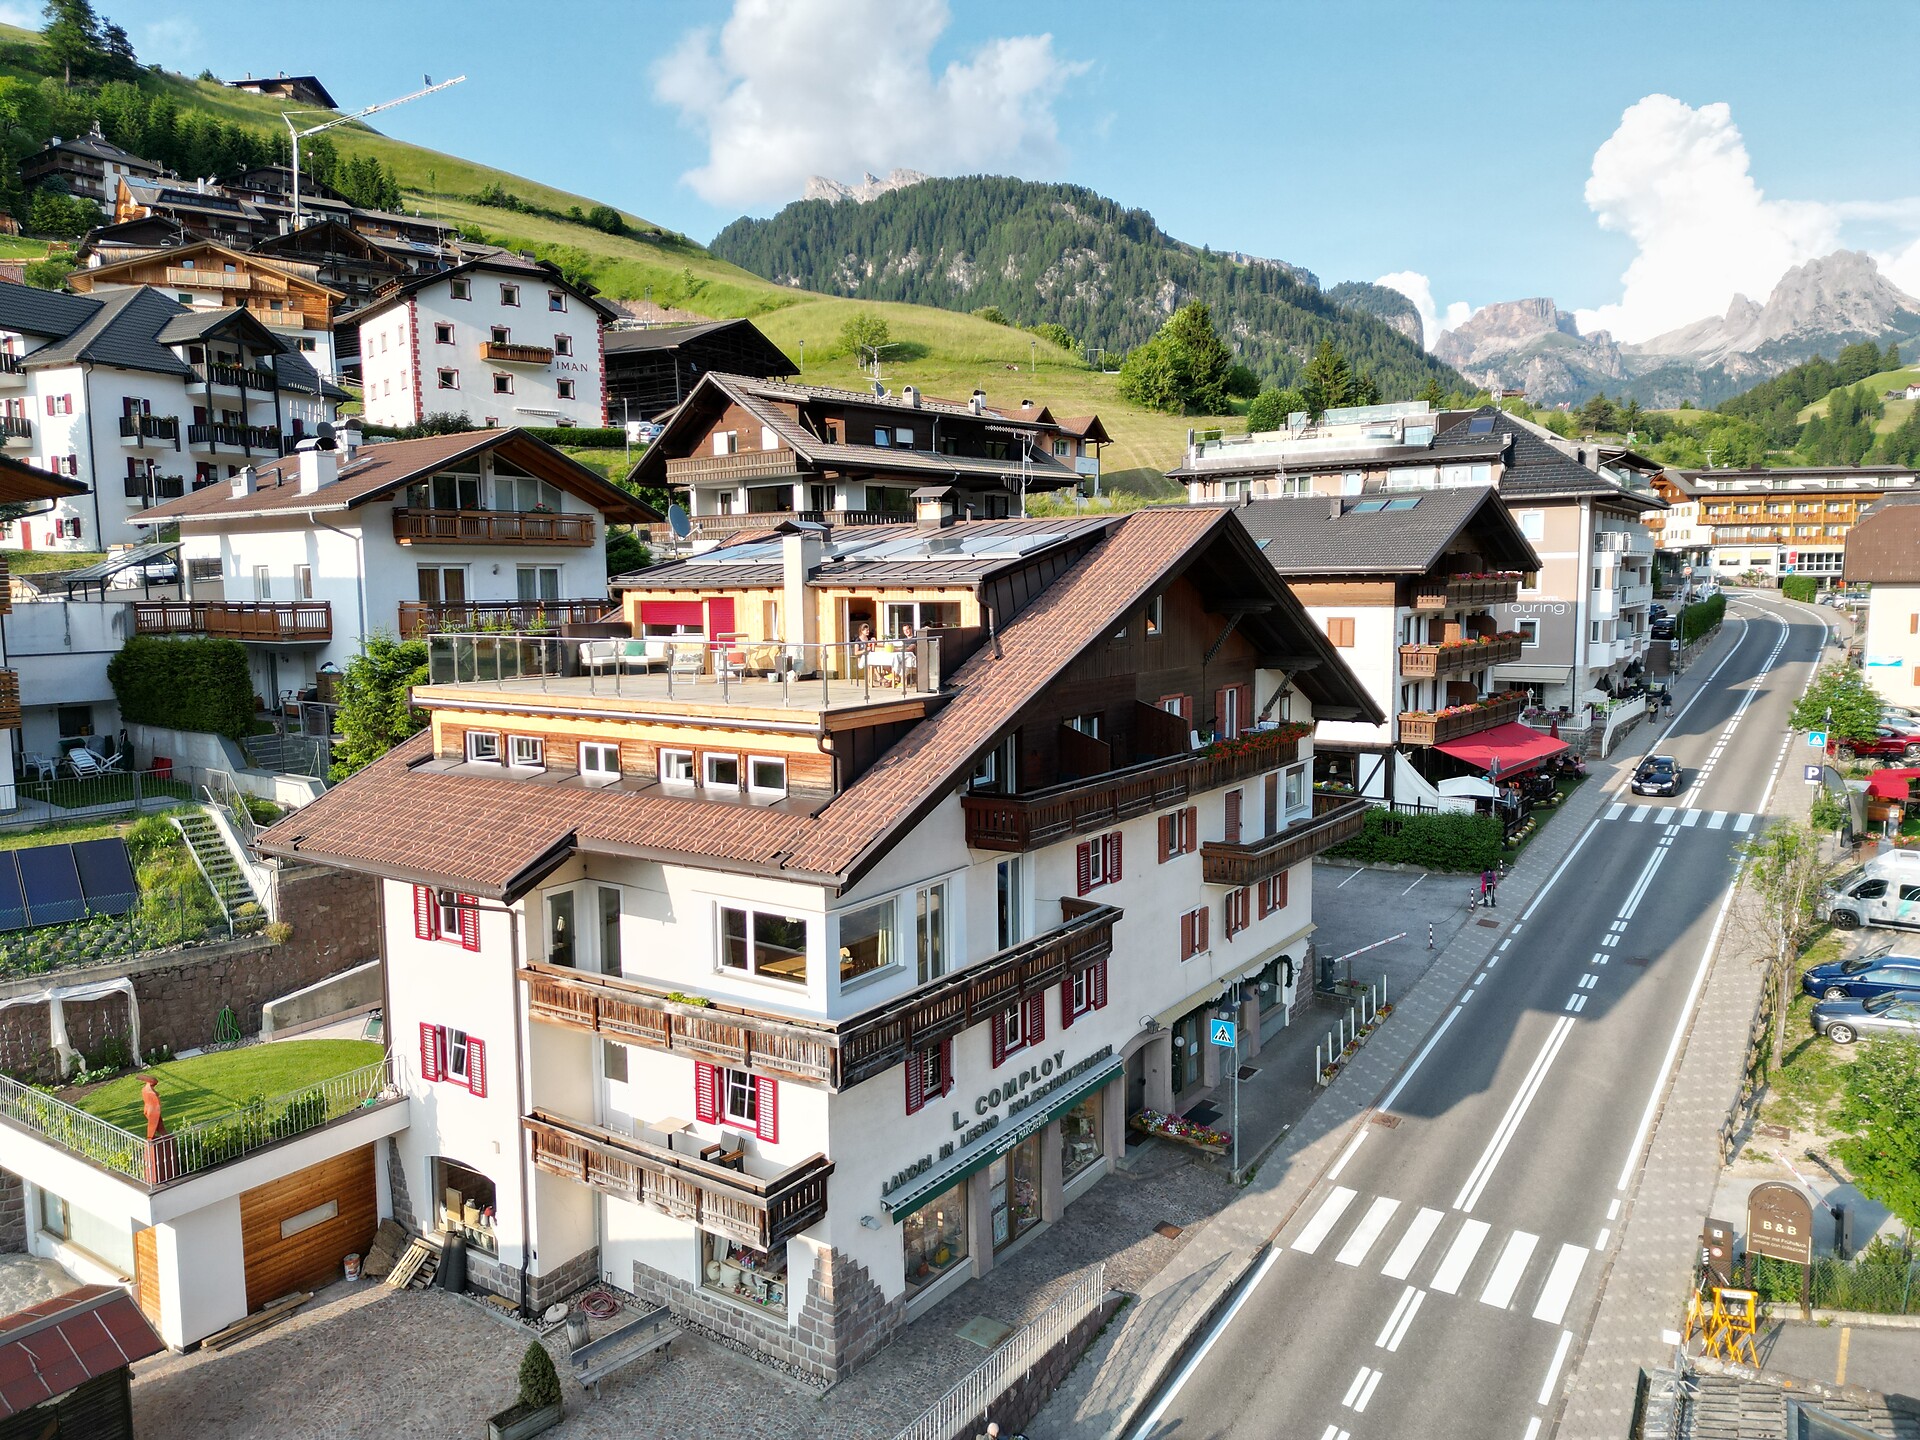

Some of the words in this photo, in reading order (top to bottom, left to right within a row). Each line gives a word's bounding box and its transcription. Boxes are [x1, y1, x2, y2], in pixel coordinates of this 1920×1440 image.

[556, 361, 588, 372] IMAN
[1503, 602, 1565, 615] Touring
[1807, 766, 1819, 779] P
[951, 1110, 969, 1131] L.
[975, 1049, 1065, 1116] COMPLOY
[882, 1154, 933, 1196] LAVORI
[939, 1140, 954, 1162] IN
[960, 1113, 1000, 1149] LEGNO
